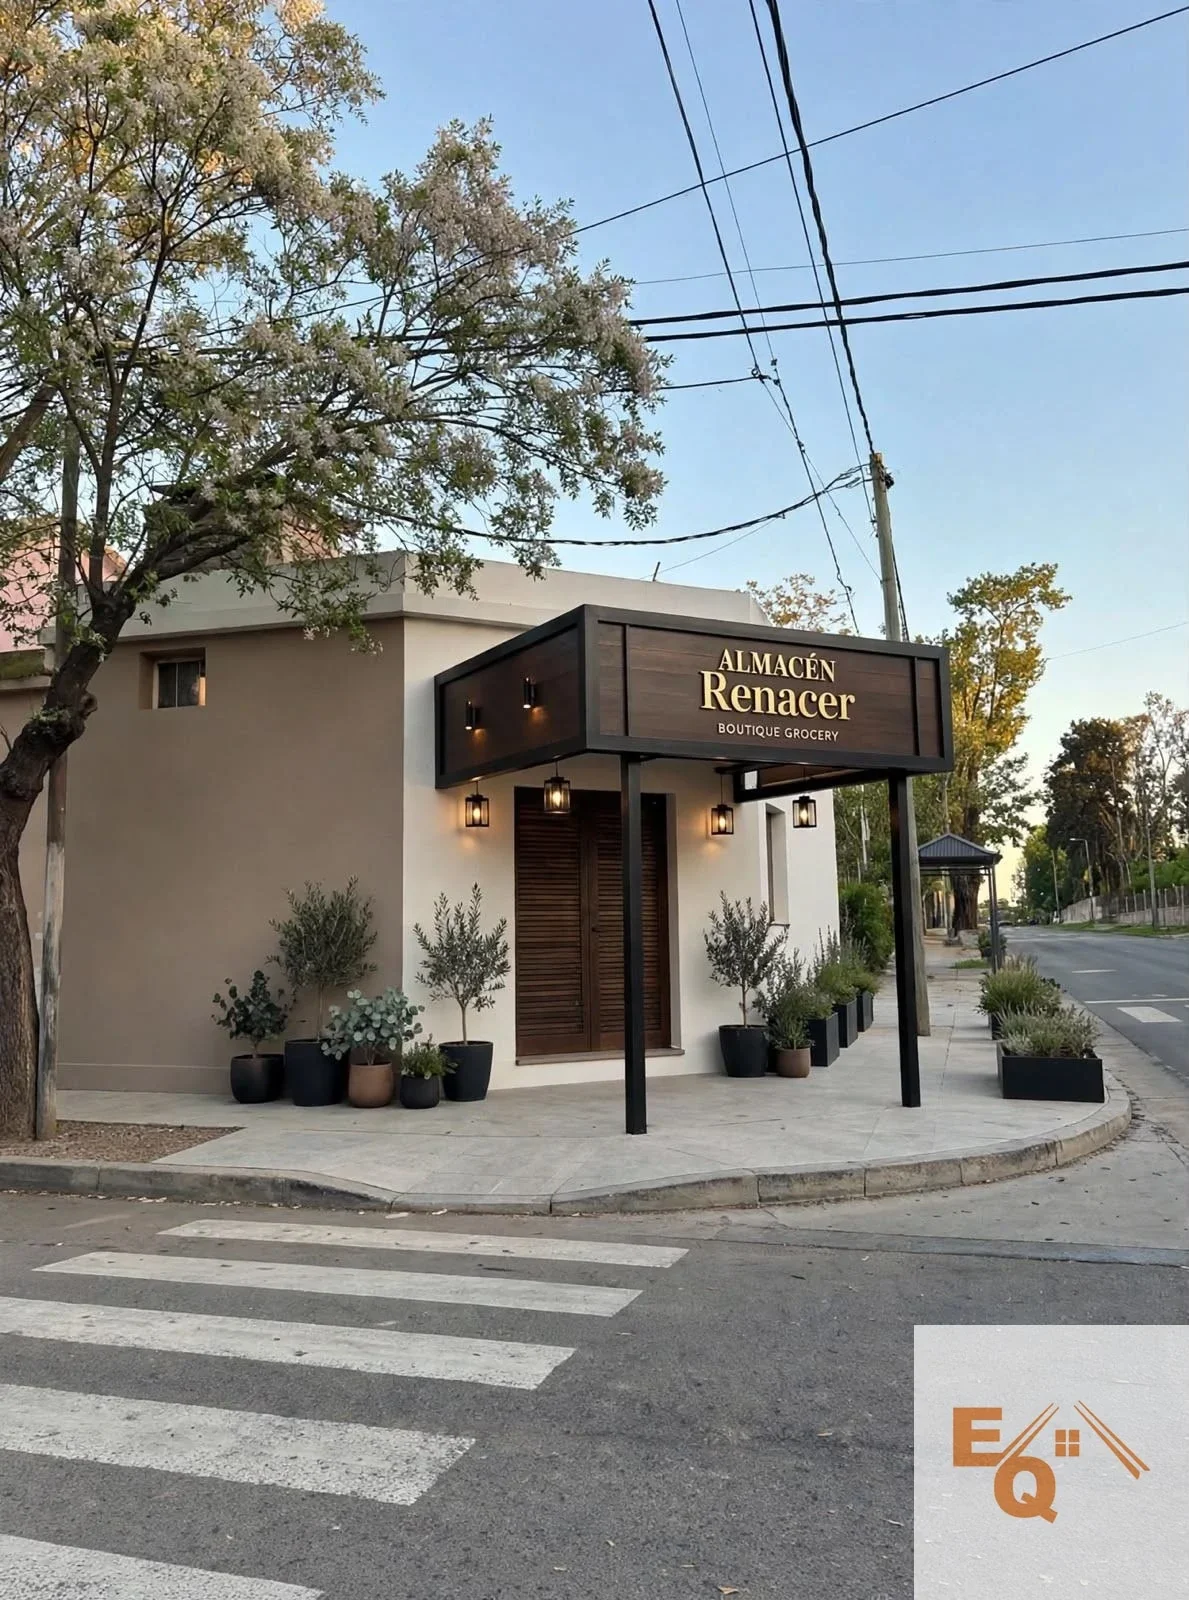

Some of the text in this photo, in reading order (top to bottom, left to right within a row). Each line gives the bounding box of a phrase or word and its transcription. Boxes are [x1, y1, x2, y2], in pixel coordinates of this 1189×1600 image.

[718, 648, 837, 682] ALMACÉN
[700, 670, 856, 721] Renacer
[718, 722, 839, 742] BOUTIQUE GROCERY
